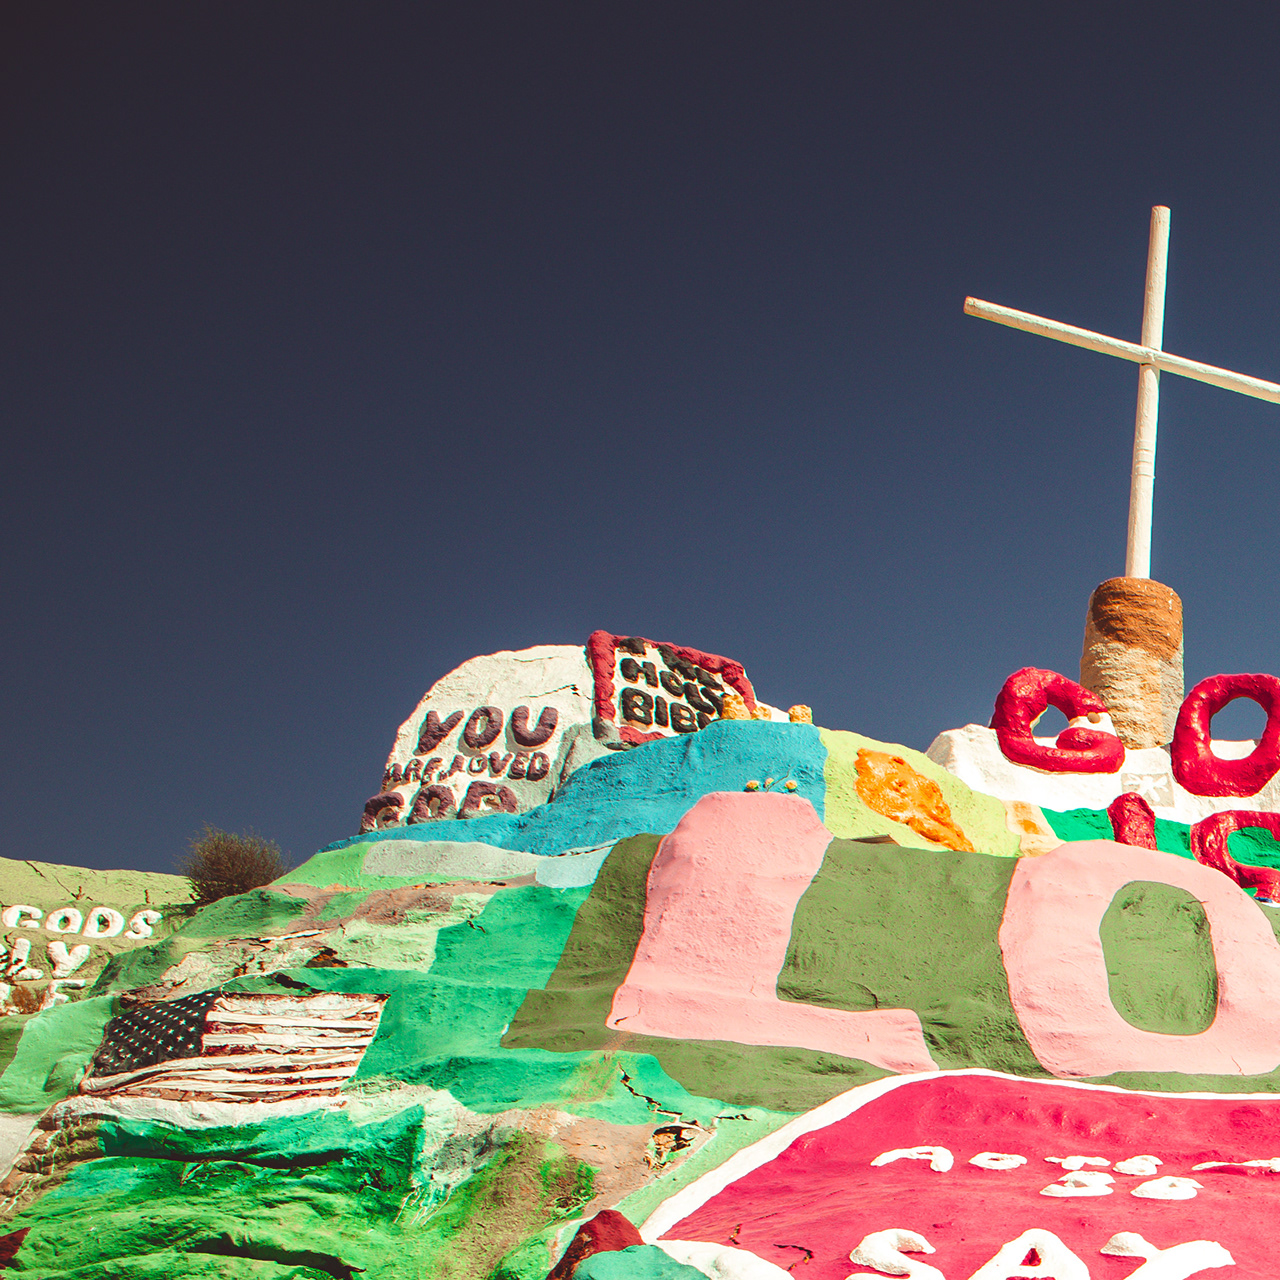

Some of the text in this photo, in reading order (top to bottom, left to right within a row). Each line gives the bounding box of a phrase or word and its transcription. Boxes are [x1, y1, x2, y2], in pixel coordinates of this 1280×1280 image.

[417, 705, 559, 755] YOU
[447, 751, 550, 781] LOVED
[1, 904, 164, 940] GODS
